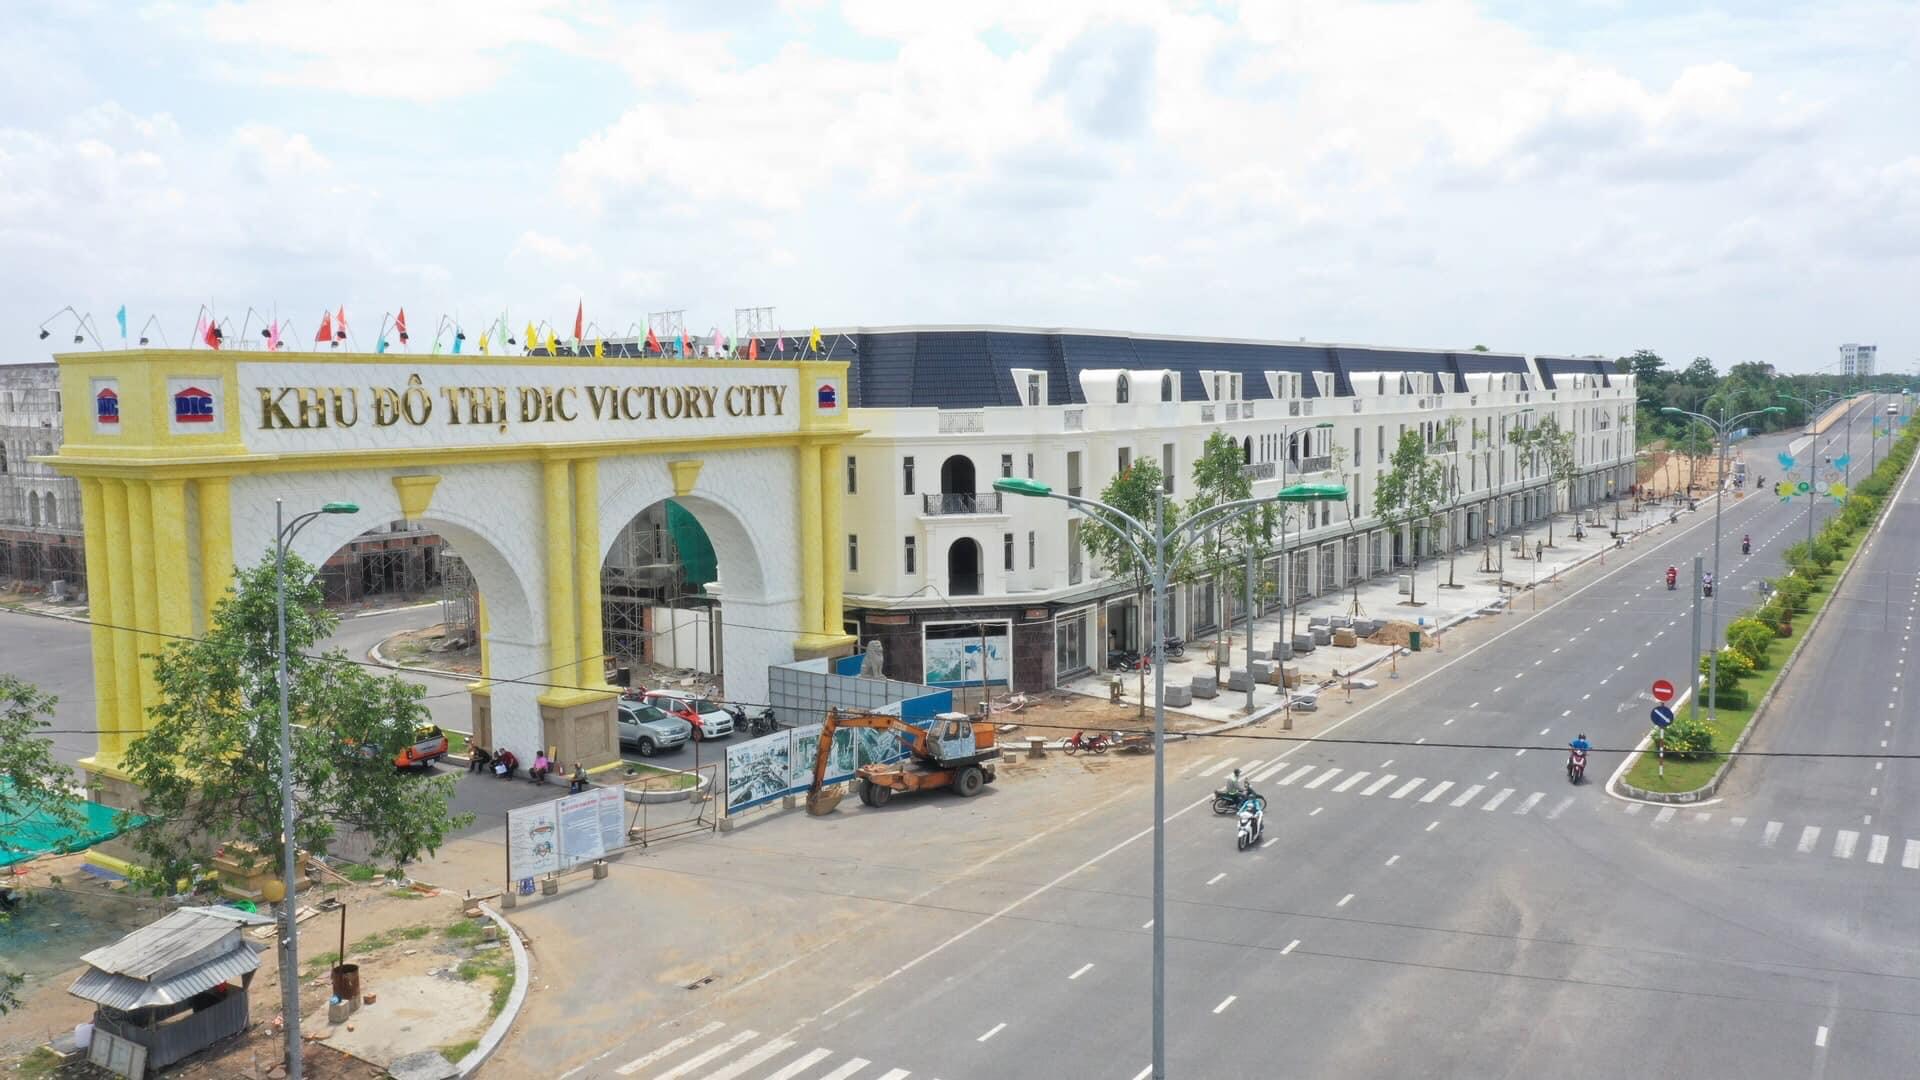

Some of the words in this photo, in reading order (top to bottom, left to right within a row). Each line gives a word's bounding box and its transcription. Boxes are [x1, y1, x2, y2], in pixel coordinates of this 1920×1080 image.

[175, 397, 213, 414] DIC
[256, 387, 358, 429] KHU
[370, 373, 432, 426] ĐÔ
[440, 386, 507, 432] THỊ
[517, 385, 578, 422] DIC
[584, 384, 718, 420] VICTORY
[724, 384, 788, 417] CITY
